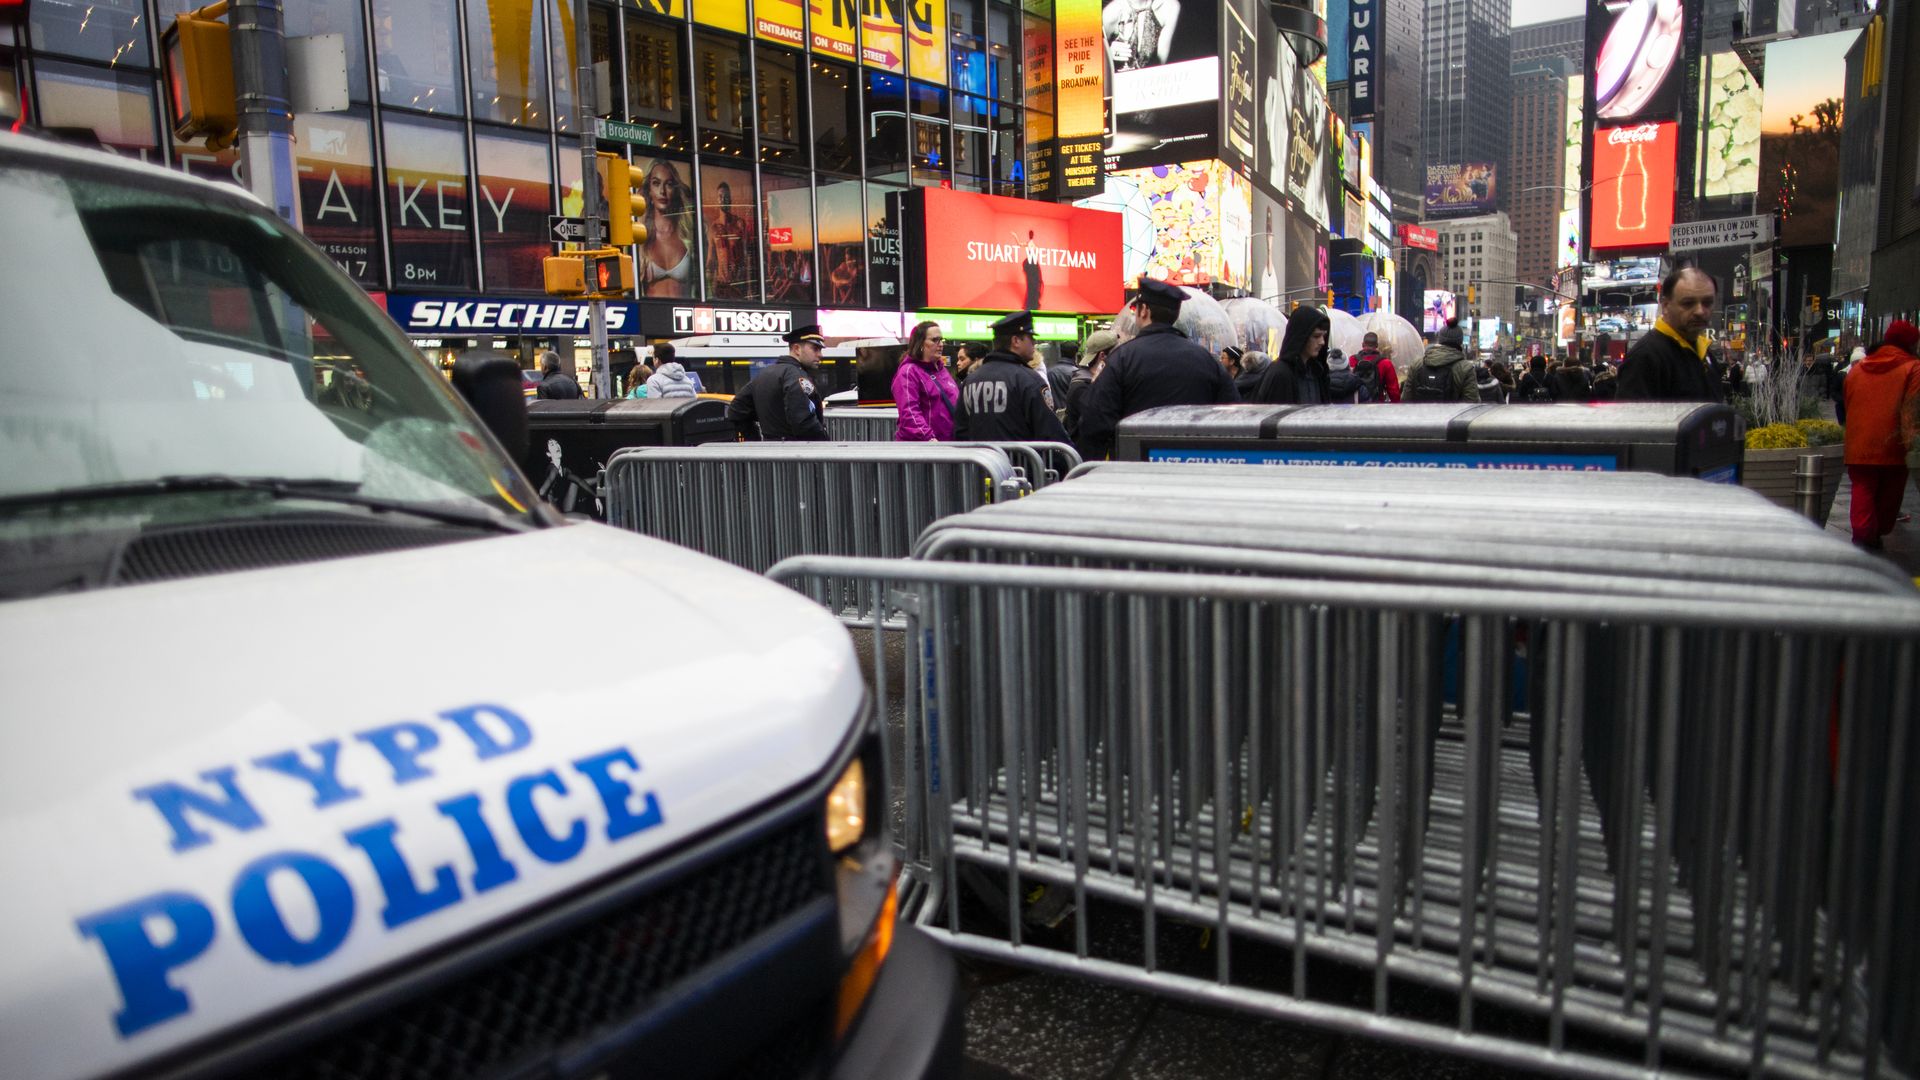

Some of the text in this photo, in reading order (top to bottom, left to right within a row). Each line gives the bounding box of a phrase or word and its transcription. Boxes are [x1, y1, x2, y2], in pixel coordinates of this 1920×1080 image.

[759, 20, 887, 64] ENTRANCE ON 45TH STREET
[1064, 36, 1094, 49] SEE THE
[1353, 0, 1371, 98] UARE
[1068, 50, 1091, 62] PRIDE
[1075, 64, 1084, 74] OF
[1061, 76, 1099, 89] BROADWAY
[608, 123, 652, 145] Broadway
[1607, 123, 1660, 145] Coca-Cola
[1061, 142, 1101, 154] GET TICKETS
[1070, 154, 1092, 165] AT THE
[1067, 176, 1096, 187] THEATRE
[397, 176, 516, 233] KEY
[560, 224, 578, 235] ONE
[1672, 220, 1759, 236] PEDESTRIAN FLOW ZONE
[871, 236, 900, 255] TUES
[1672, 235, 1720, 247] KEEP MOVING
[330, 245, 367, 255] SEASON
[967, 241, 1096, 269] STUART WEITZMAN
[872, 256, 885, 265] JAN
[885, 257, 890, 265] 7
[404, 263, 437, 281] 8PM
[716, 311, 790, 332] TISSOT
[963, 381, 1008, 416] NYPD
[132, 701, 535, 854] NYPD
[77, 746, 666, 1040] POLICE
